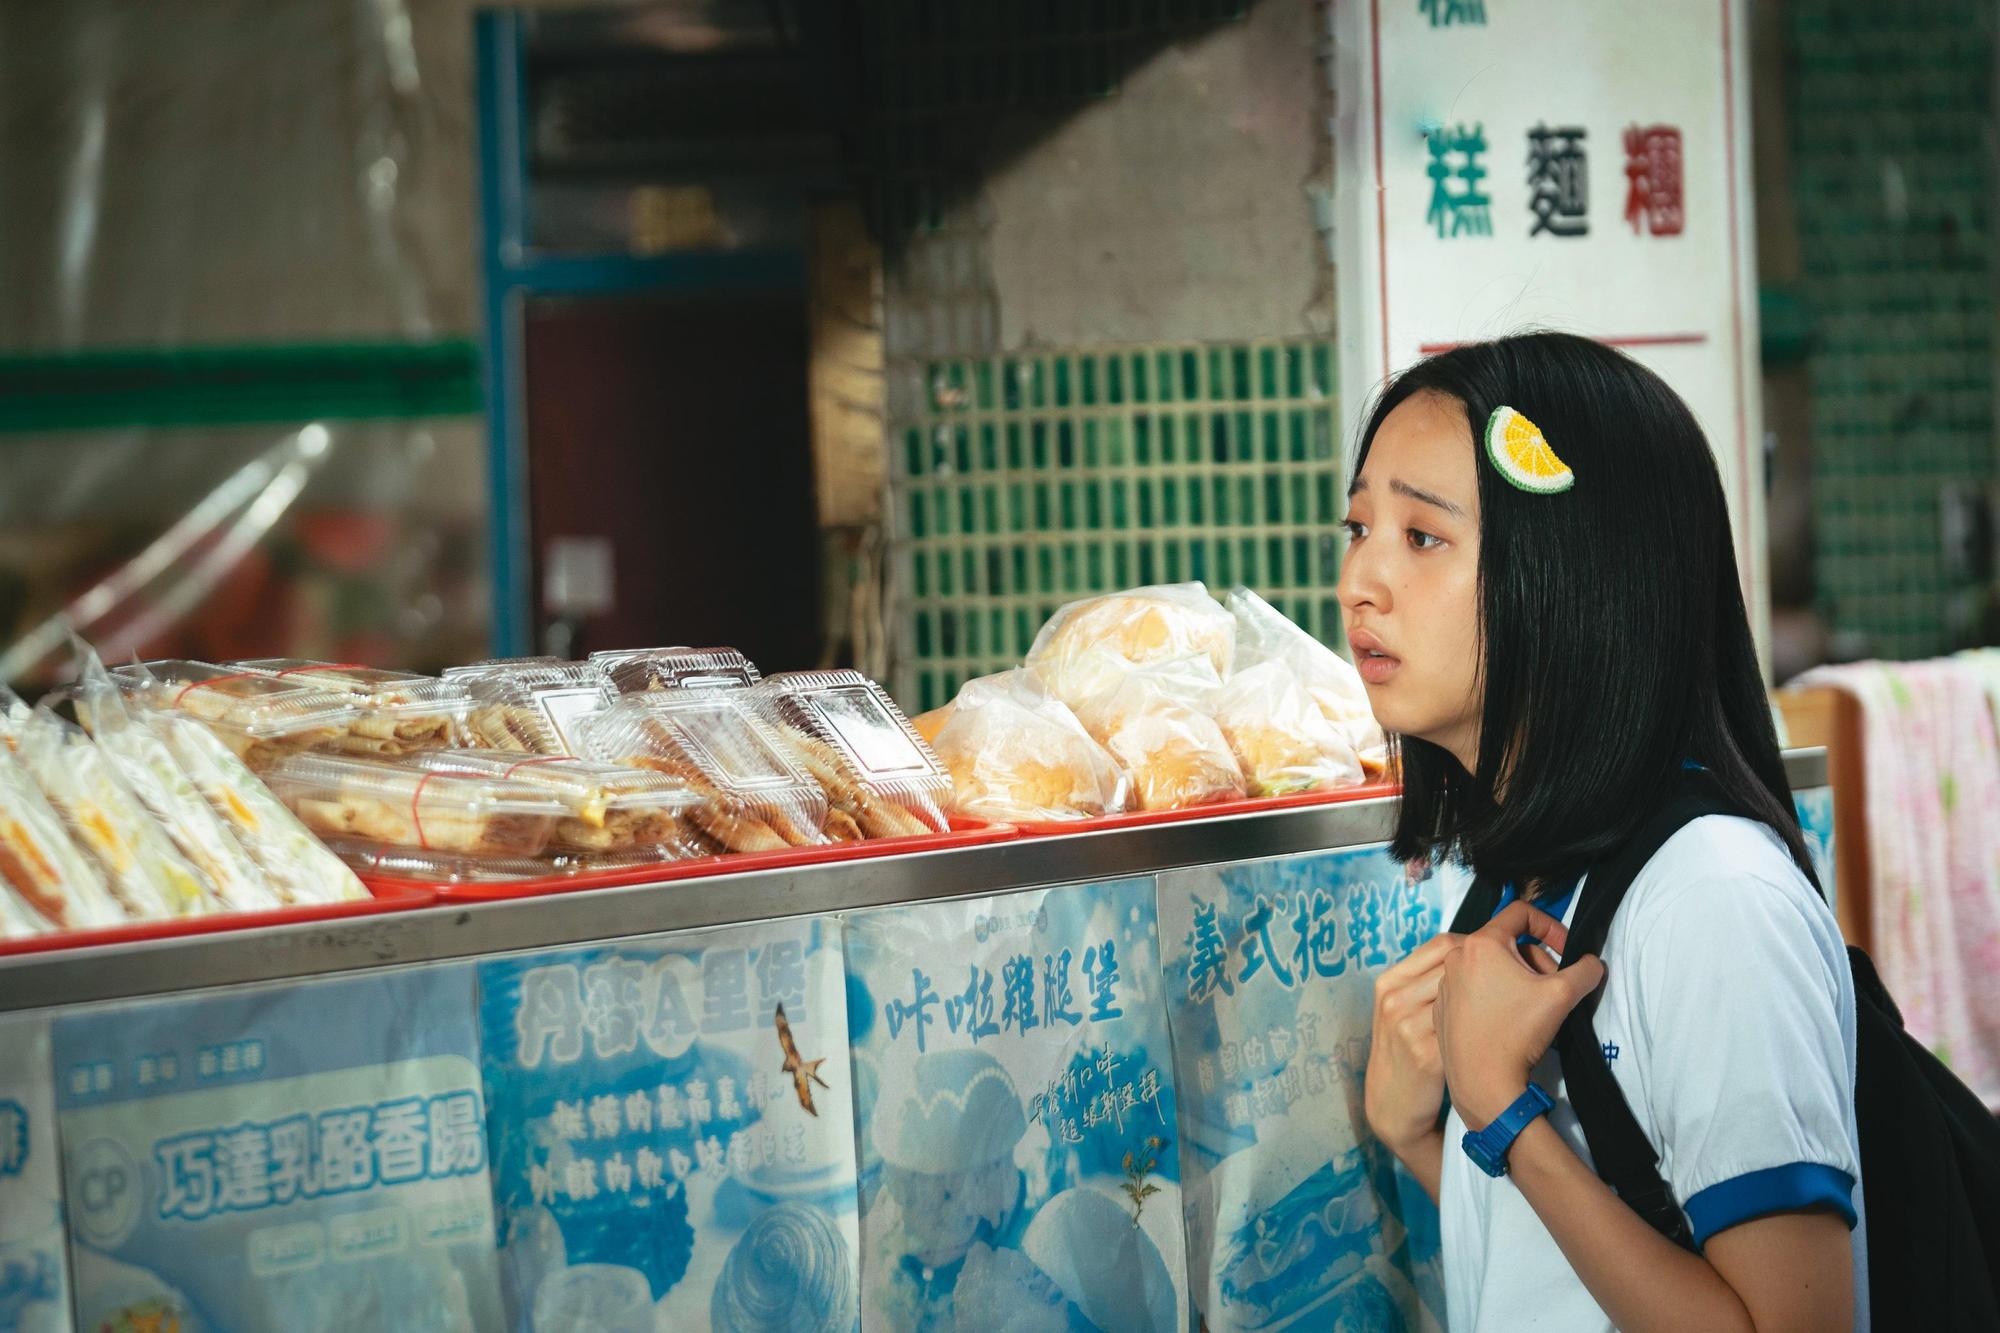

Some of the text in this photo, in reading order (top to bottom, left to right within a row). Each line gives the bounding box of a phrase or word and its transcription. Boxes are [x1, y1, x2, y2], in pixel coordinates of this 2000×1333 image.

[1526, 121, 1591, 237] 麵
[884, 938, 1124, 1053] 咔啦雞腿堡
[1602, 1039, 1620, 1070] 中
[154, 1090, 486, 1220] 巧達乳酪香腸
